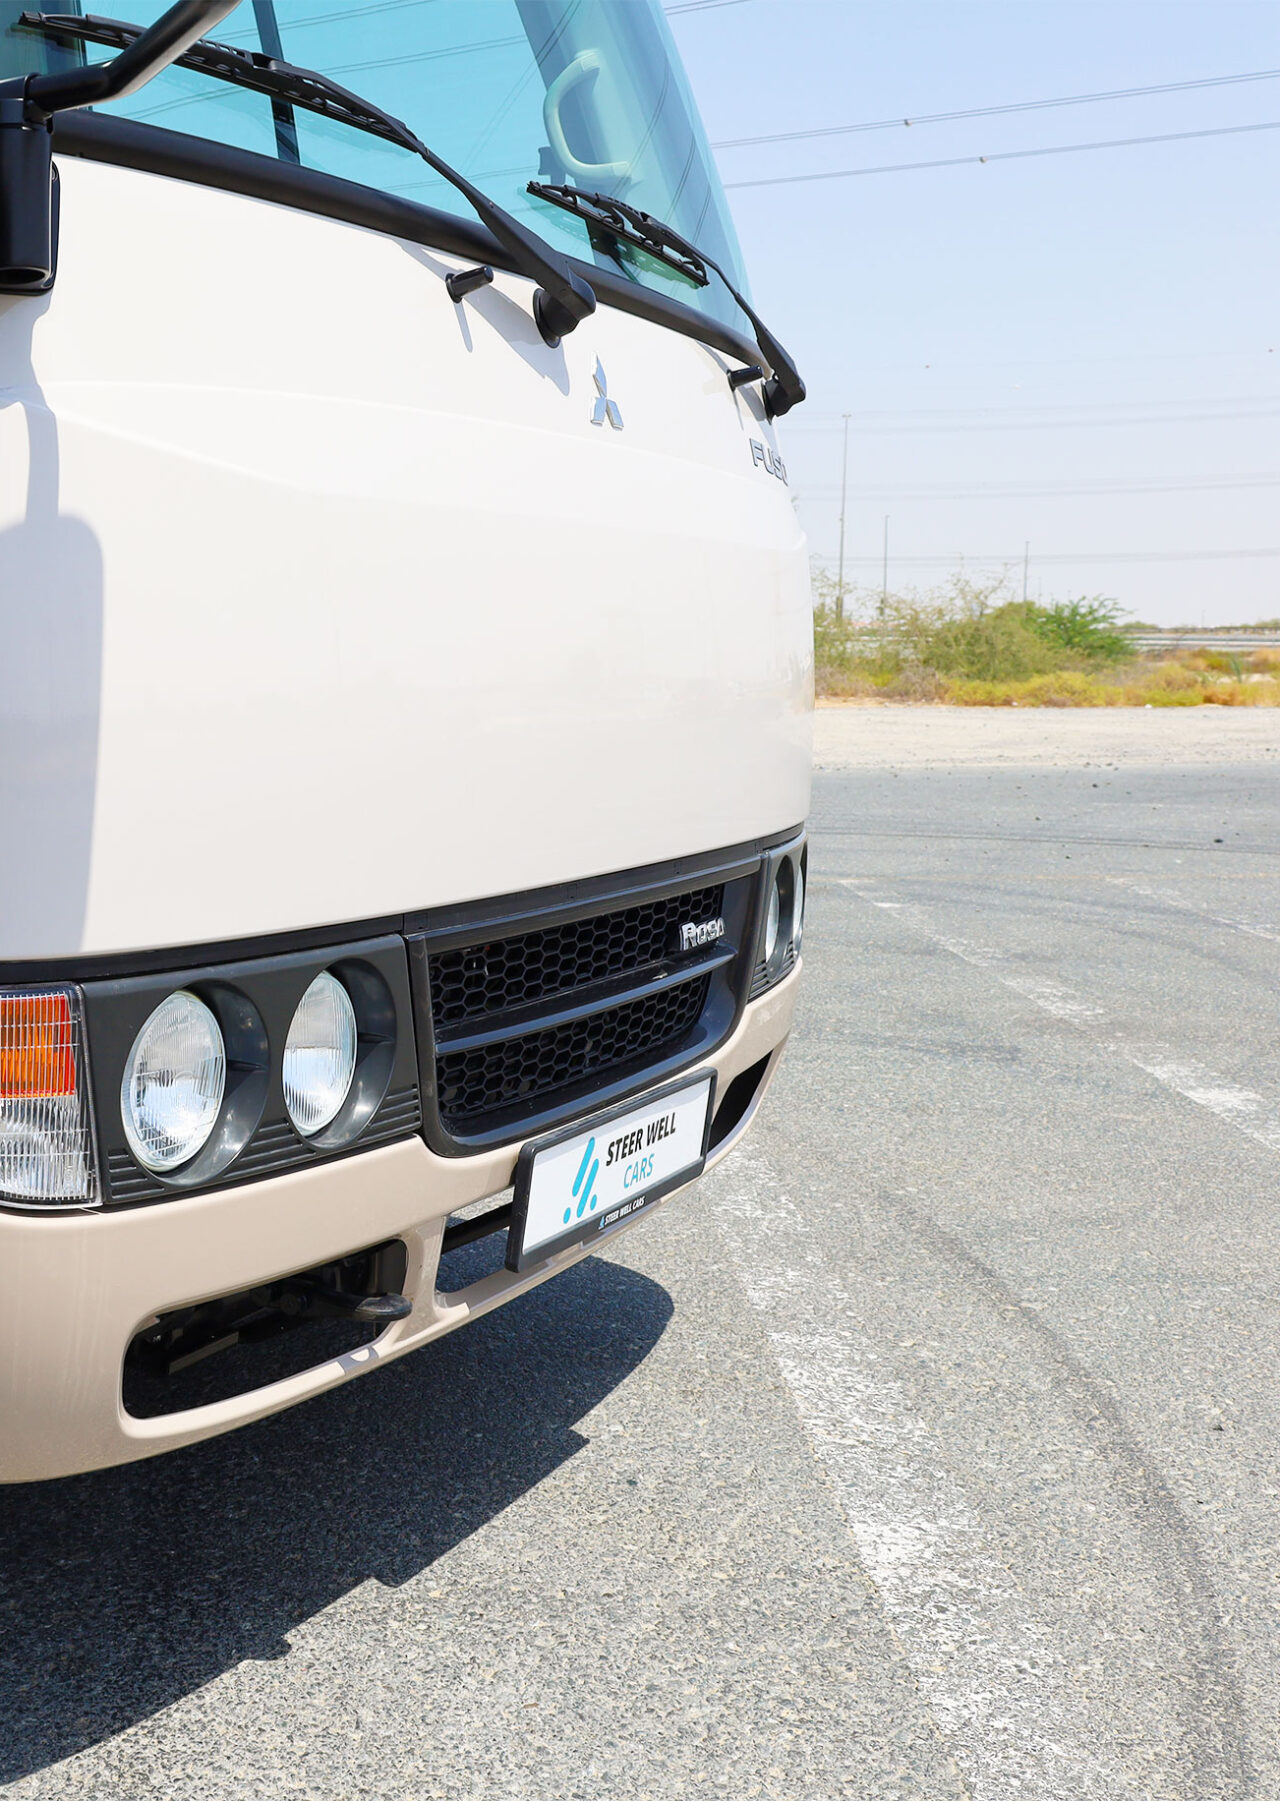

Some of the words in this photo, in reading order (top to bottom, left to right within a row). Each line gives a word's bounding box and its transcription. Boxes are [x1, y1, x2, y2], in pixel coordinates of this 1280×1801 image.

[606, 1128, 644, 1167] STEER
[646, 1112, 676, 1146] WELL
[623, 1153, 655, 1189] CARS
[632, 1196, 645, 1210] CARS
